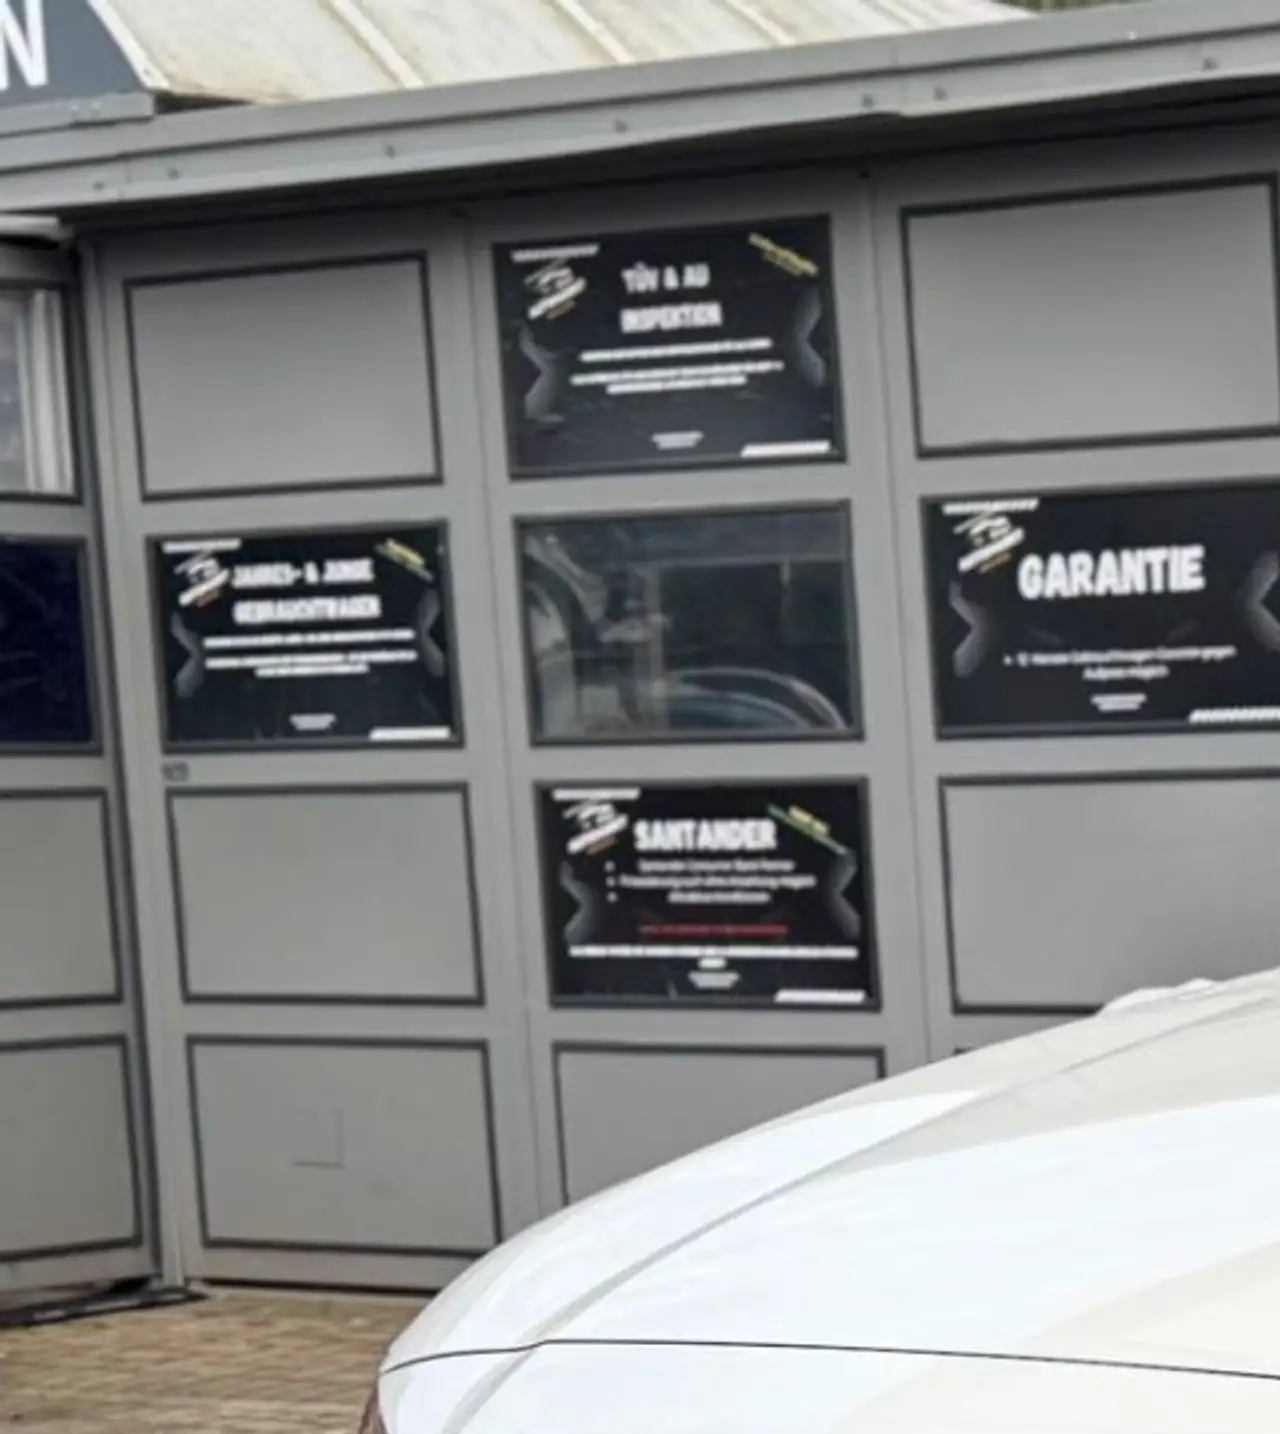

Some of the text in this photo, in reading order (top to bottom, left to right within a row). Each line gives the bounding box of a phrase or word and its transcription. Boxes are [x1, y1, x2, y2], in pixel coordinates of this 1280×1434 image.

[620, 260, 659, 295] TÜV
[1017, 543, 1207, 602] GARANTIE
[633, 818, 779, 852] SANTANDER
